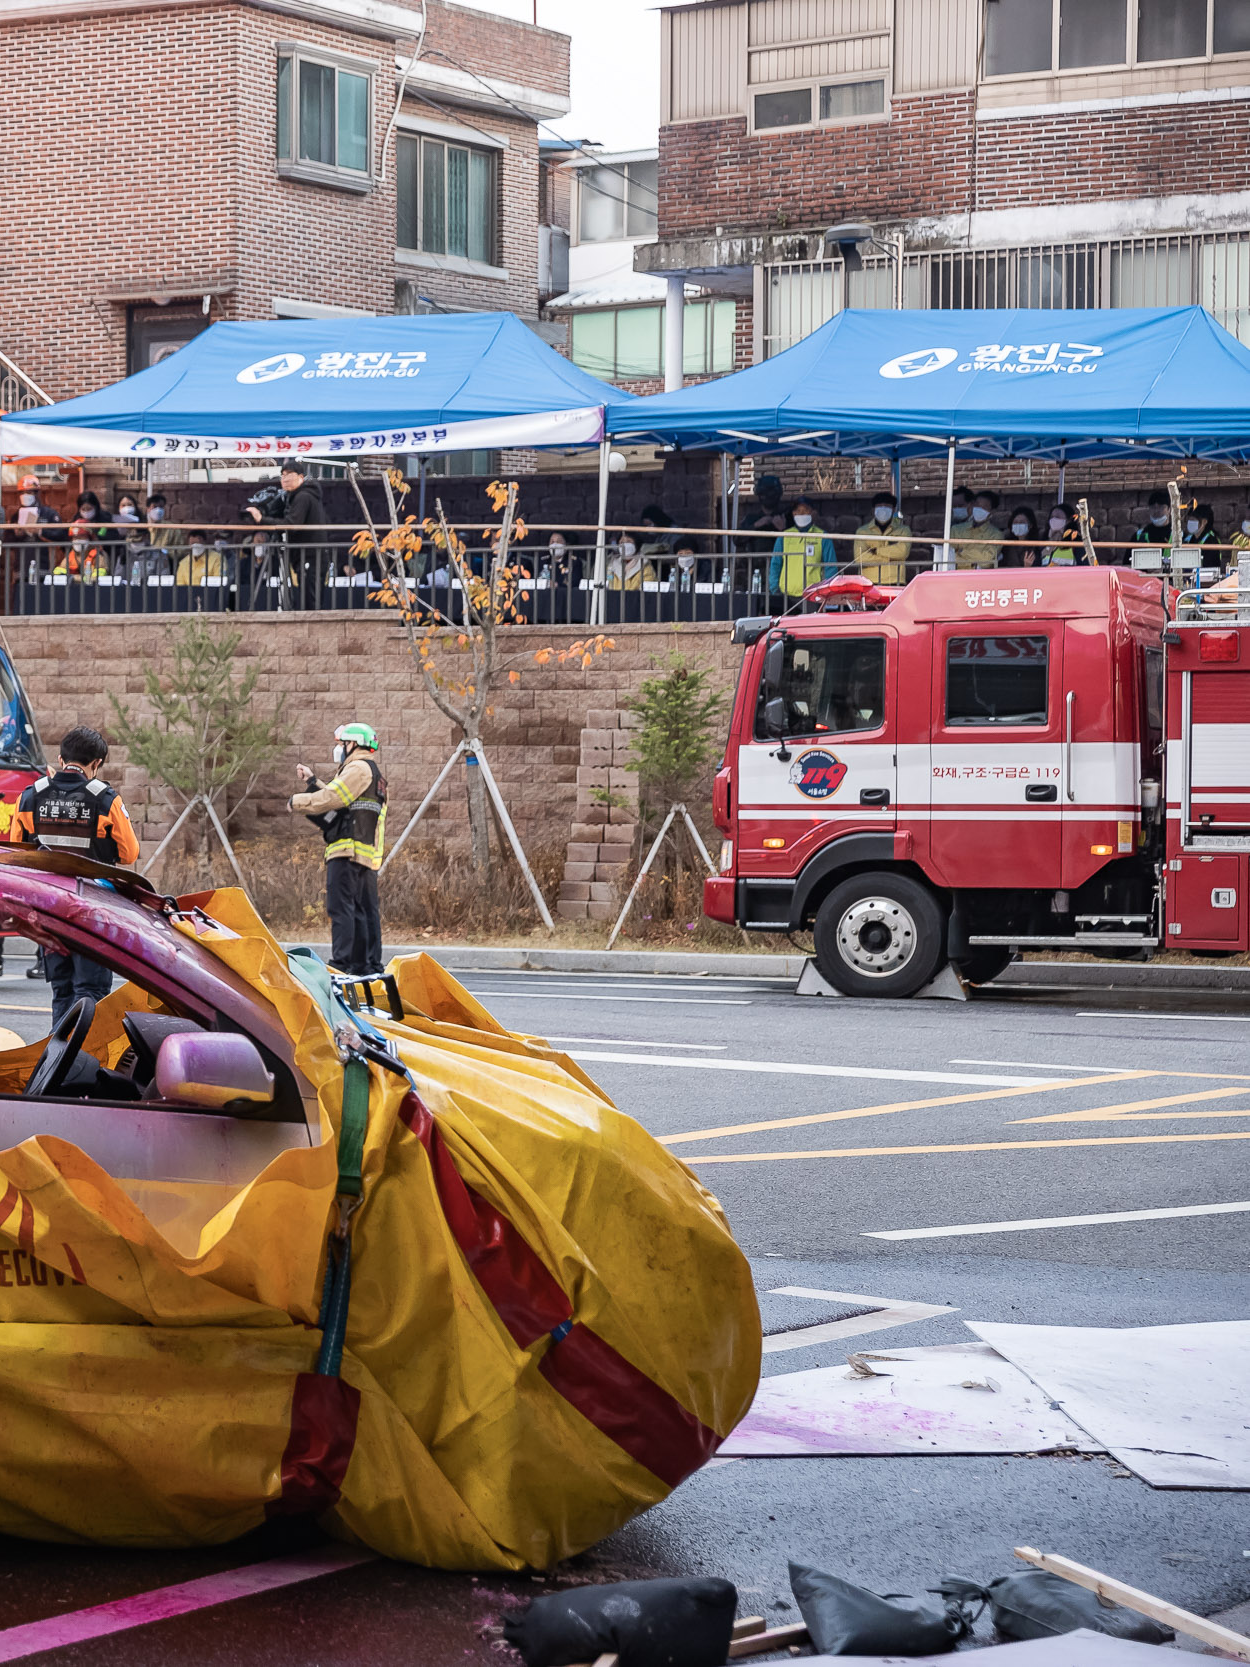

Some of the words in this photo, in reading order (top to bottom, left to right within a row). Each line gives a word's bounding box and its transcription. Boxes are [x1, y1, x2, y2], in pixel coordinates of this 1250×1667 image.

[314, 351, 427, 370] 광진구
[969, 342, 1104, 364] 광진구
[301, 367, 421, 380] GWANGJIN-GU
[957, 362, 1098, 374] GWANGJIN-GU
[164, 437, 219, 453] 광진구
[964, 588, 1028, 609] 광진중곡
[1033, 588, 1043, 604] P
[801, 762, 849, 789] 119
[932, 766, 1031, 779] 화재,구조·구급은
[1036, 767, 1061, 778] 119
